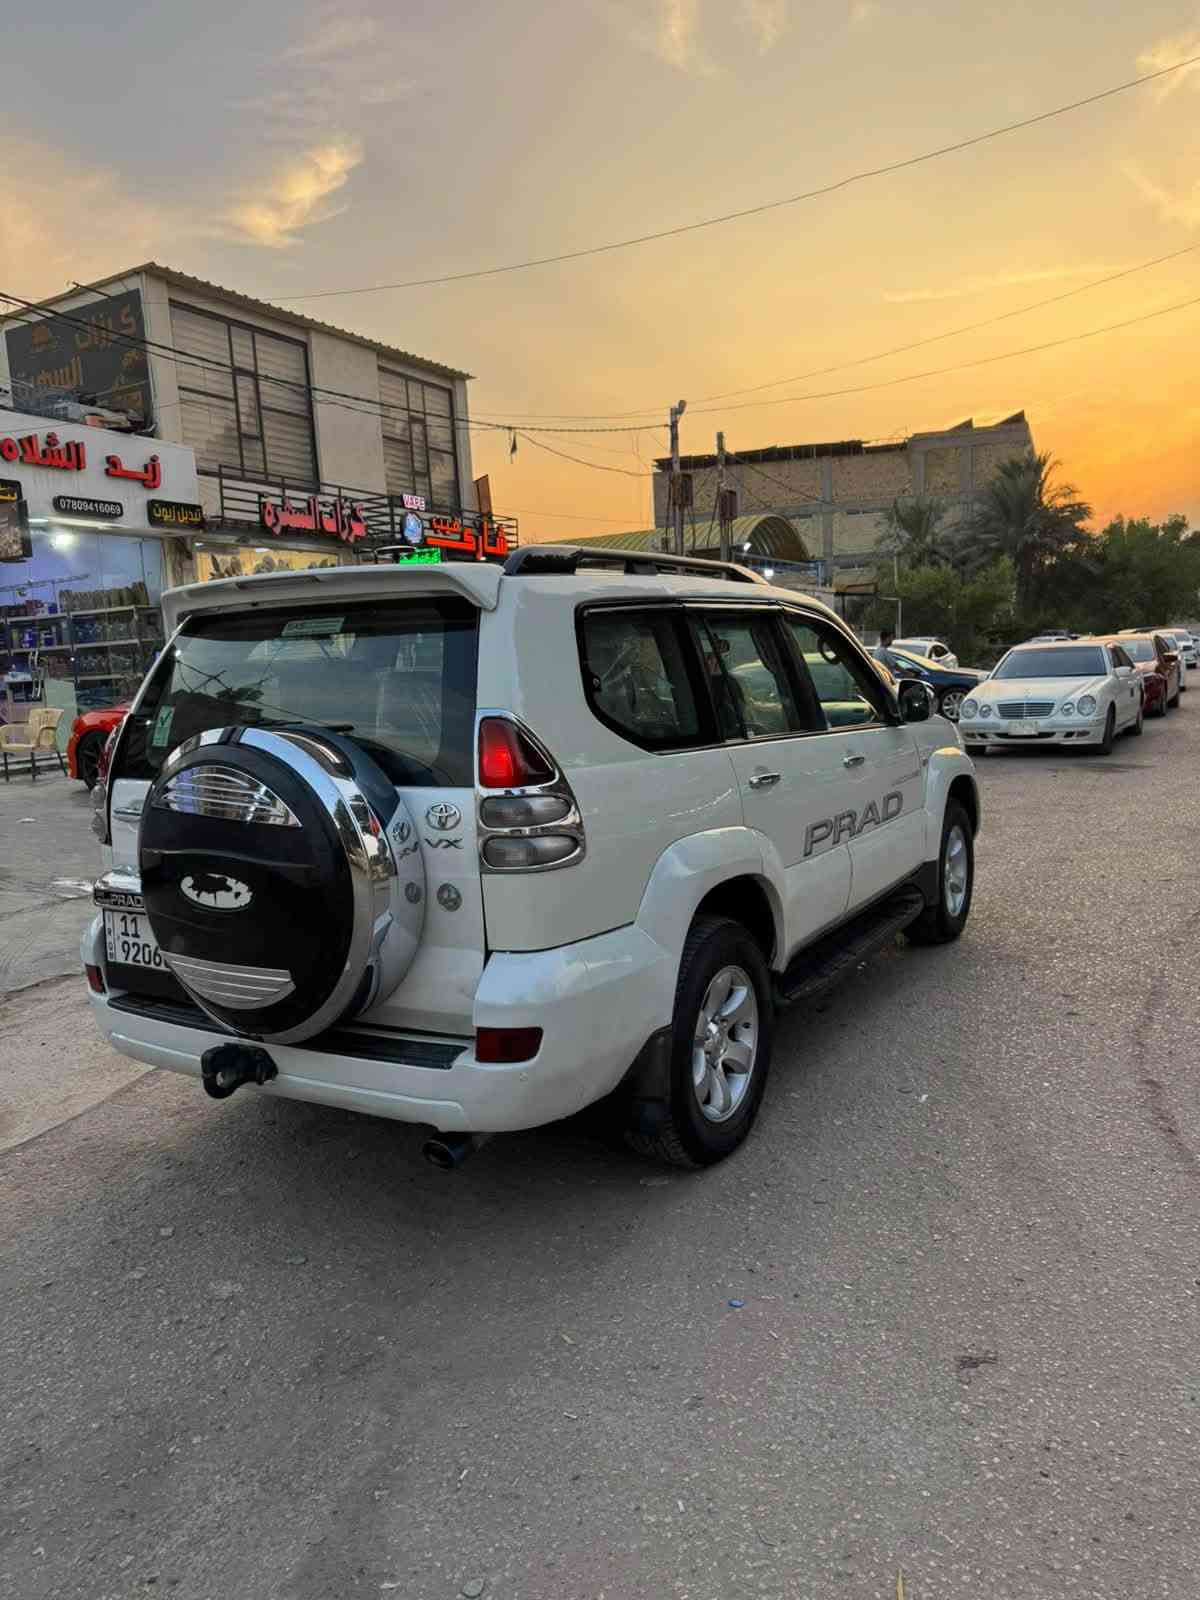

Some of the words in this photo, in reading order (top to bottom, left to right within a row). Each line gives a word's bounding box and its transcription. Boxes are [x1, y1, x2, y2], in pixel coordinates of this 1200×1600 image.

[59, 498, 121, 515] 07809416069
[803, 791, 904, 857] PRAD
[424, 838, 464, 850] VX
[120, 915, 141, 938] 11
[121, 940, 169, 968] 9206
